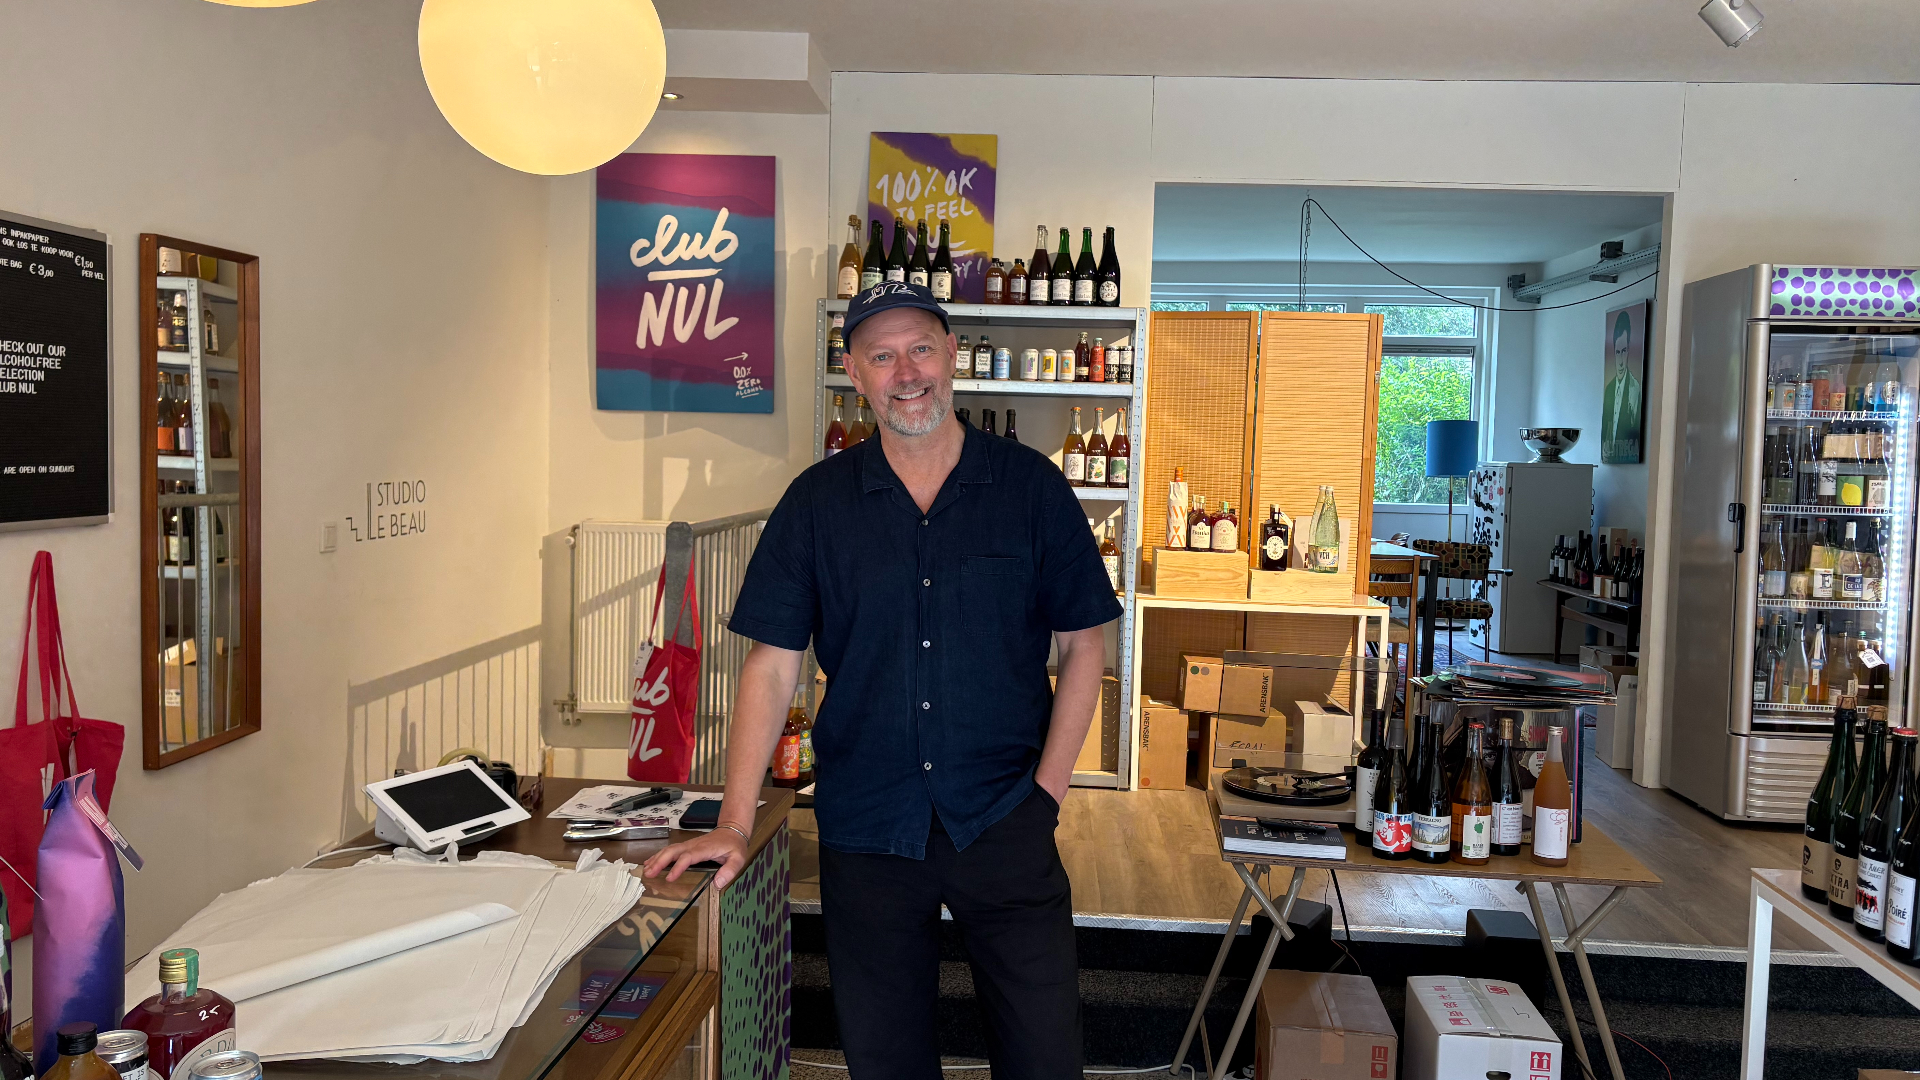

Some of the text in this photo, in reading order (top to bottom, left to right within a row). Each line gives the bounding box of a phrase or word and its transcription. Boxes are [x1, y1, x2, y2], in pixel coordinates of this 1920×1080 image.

[876, 166, 978, 207] 100% OK
[925, 197, 974, 220] FEEL
[10, 228, 50, 244] INPAKPAPIER
[629, 206, 739, 268] club
[2, 237, 15, 248] OOK
[17, 241, 28, 250] LOS
[31, 243, 39, 252] TE
[41, 245, 58, 255] KOOP
[58, 249, 75, 259] VOOR
[10, 259, 23, 269] BAG
[81, 269, 105, 281] PER VEL
[635, 278, 740, 350] NUL
[0, 340, 66, 357] HECK OUT OUR
[0, 354, 62, 369] LCOHOLFREE
[0, 367, 45, 381] ELECTION
[736, 378, 761, 390] ZERO
[0, 381, 38, 395] LUB NUL
[4, 466, 17, 475] ARE
[19, 466, 36, 474] OPEN
[377, 480, 426, 507] STUDIO
[390, 510, 426, 537] BEAU
[632, 666, 670, 706] ub
[1259, 674, 1270, 714] ARENSBAK
[628, 717, 663, 762] UL
[1142, 710, 1151, 749] ARENSBAK
